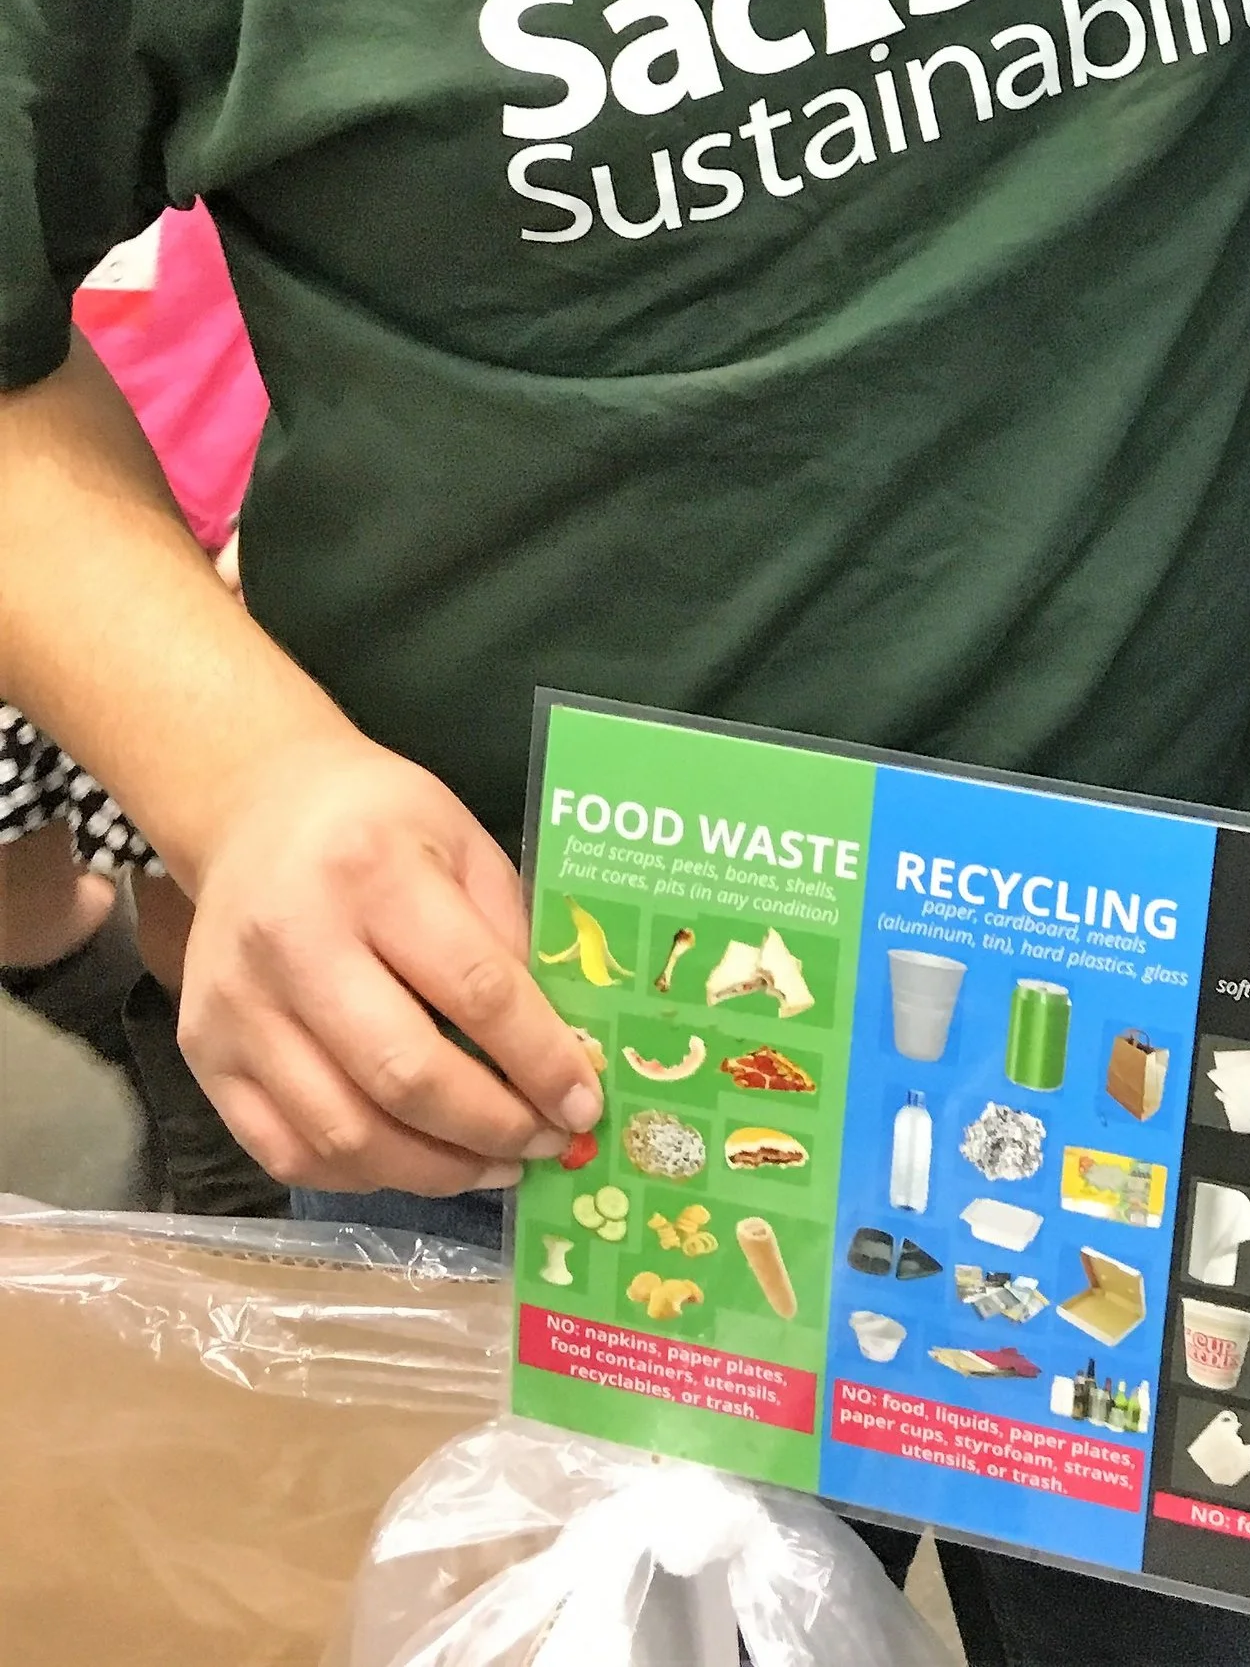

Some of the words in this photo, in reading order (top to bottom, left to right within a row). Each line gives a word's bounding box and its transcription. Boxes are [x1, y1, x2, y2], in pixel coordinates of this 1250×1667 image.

[551, 787, 685, 846] FOOD
[699, 814, 860, 880] WASTE
[563, 835, 606, 857] food
[608, 845, 666, 871] scraps,
[671, 857, 719, 881] peels,
[725, 865, 780, 892] bones,
[785, 878, 837, 901] shells,
[559, 857, 597, 880] fruit
[654, 877, 686, 898] pits
[690, 882, 712, 901] (in
[717, 890, 749, 911] any
[753, 896, 840, 926] condition)
[895, 850, 1179, 940] RECYCLING
[921, 898, 978, 924] paper,
[984, 910, 1081, 944] cardboard,
[1086, 927, 1147, 954] metals
[877, 912, 977, 949] (aluminum,
[982, 933, 1015, 956] tin),
[1020, 939, 1064, 962] hard
[1066, 949, 1138, 979] plastics,
[1141, 963, 1189, 986] glass
[546, 1314, 580, 1336] NO:
[585, 1325, 662, 1359] napkins,
[667, 1346, 722, 1369] paper
[726, 1357, 788, 1387] plates,
[550, 1335, 591, 1359] food
[596, 1348, 698, 1387] containers,
[703, 1374, 782, 1406] utensils,
[570, 1362, 676, 1403] recyclables,
[681, 1390, 701, 1405] or
[707, 1395, 761, 1421] trash.
[841, 1384, 878, 1407] NO:
[882, 1393, 930, 1421] food,
[935, 1407, 1004, 1439] liquids,
[1009, 1425, 1067, 1451] paper
[1071, 1440, 1137, 1470] plates,
[839, 1407, 896, 1433] paper
[900, 1423, 950, 1447] cups,
[954, 1434, 1058, 1472] styrofoam,
[1064, 1461, 1134, 1491] straws,
[901, 1442, 982, 1475] utensils,
[986, 1463, 1007, 1478] or
[1012, 1468, 1069, 1495] trash.
[1190, 1504, 1231, 1529] NO:
